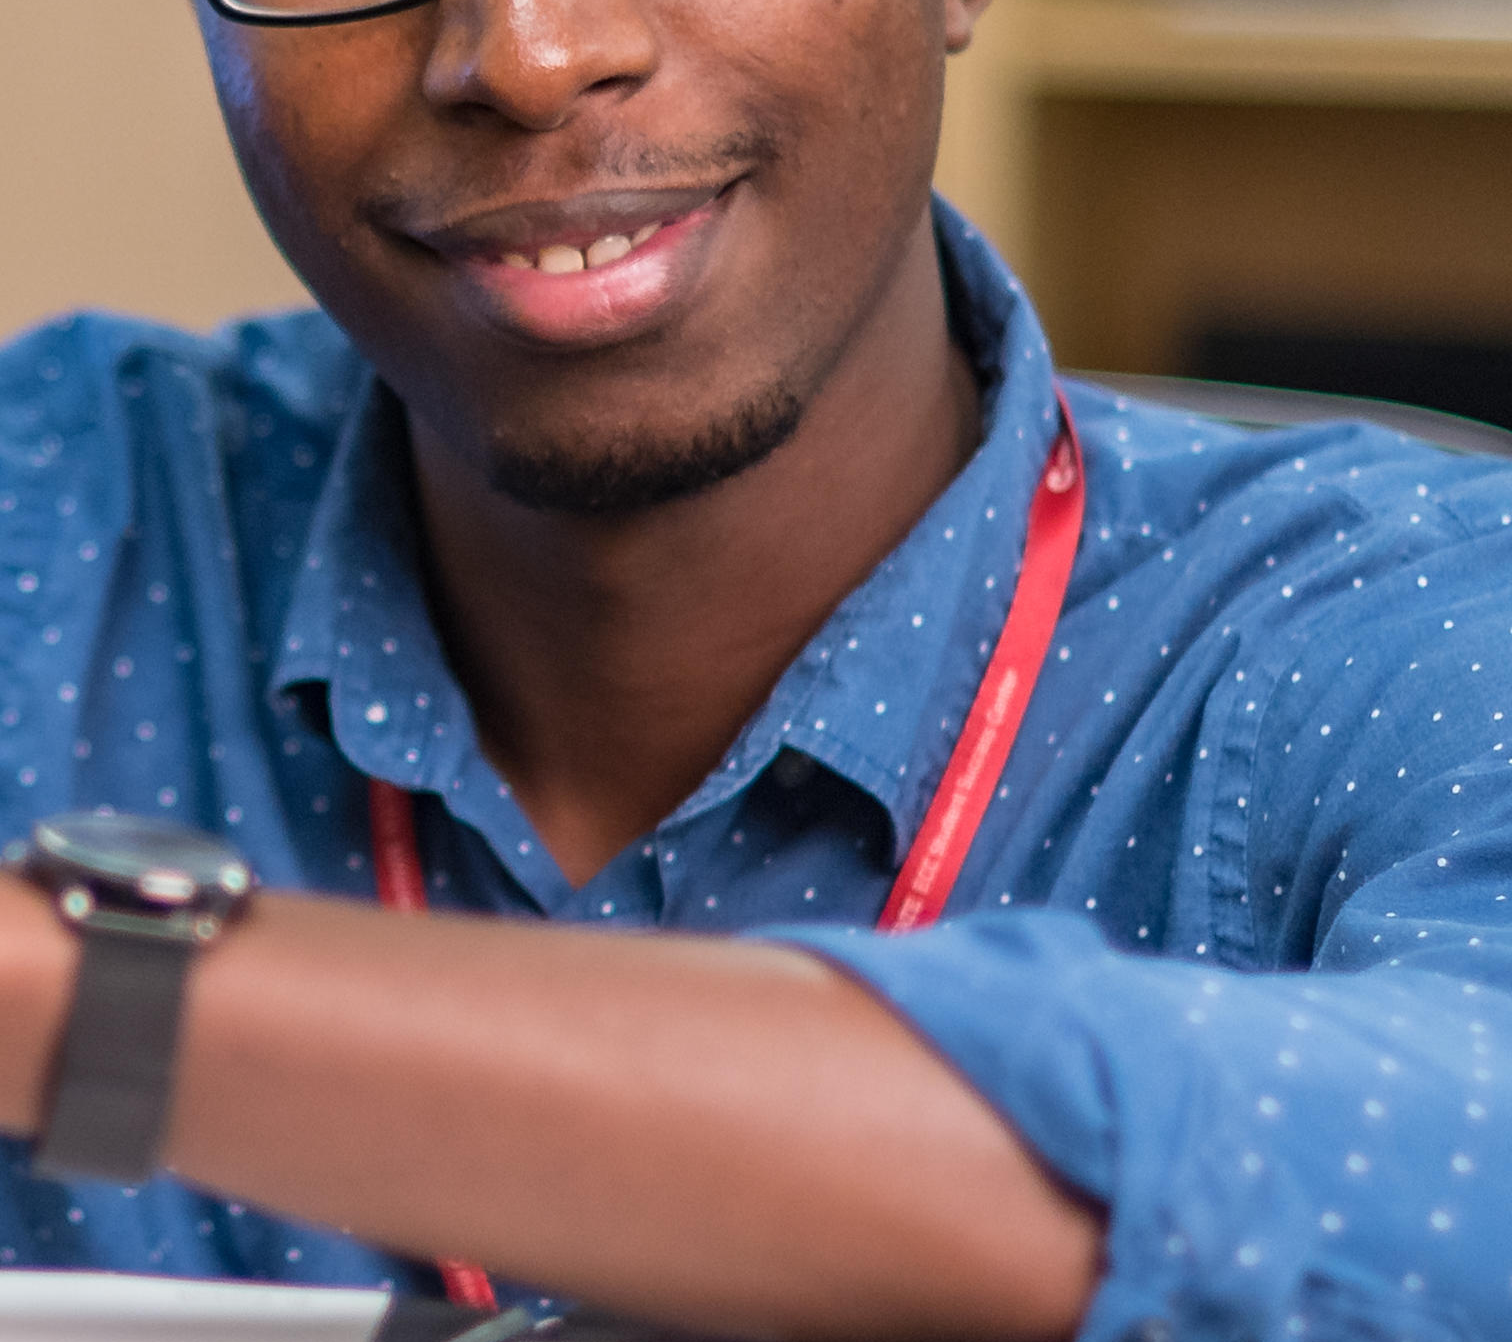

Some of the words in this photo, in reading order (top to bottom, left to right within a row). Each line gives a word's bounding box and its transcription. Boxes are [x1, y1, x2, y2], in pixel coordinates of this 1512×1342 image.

[929, 792, 968, 857] Student
[956, 726, 998, 791] Success
[986, 666, 1018, 728] Center
